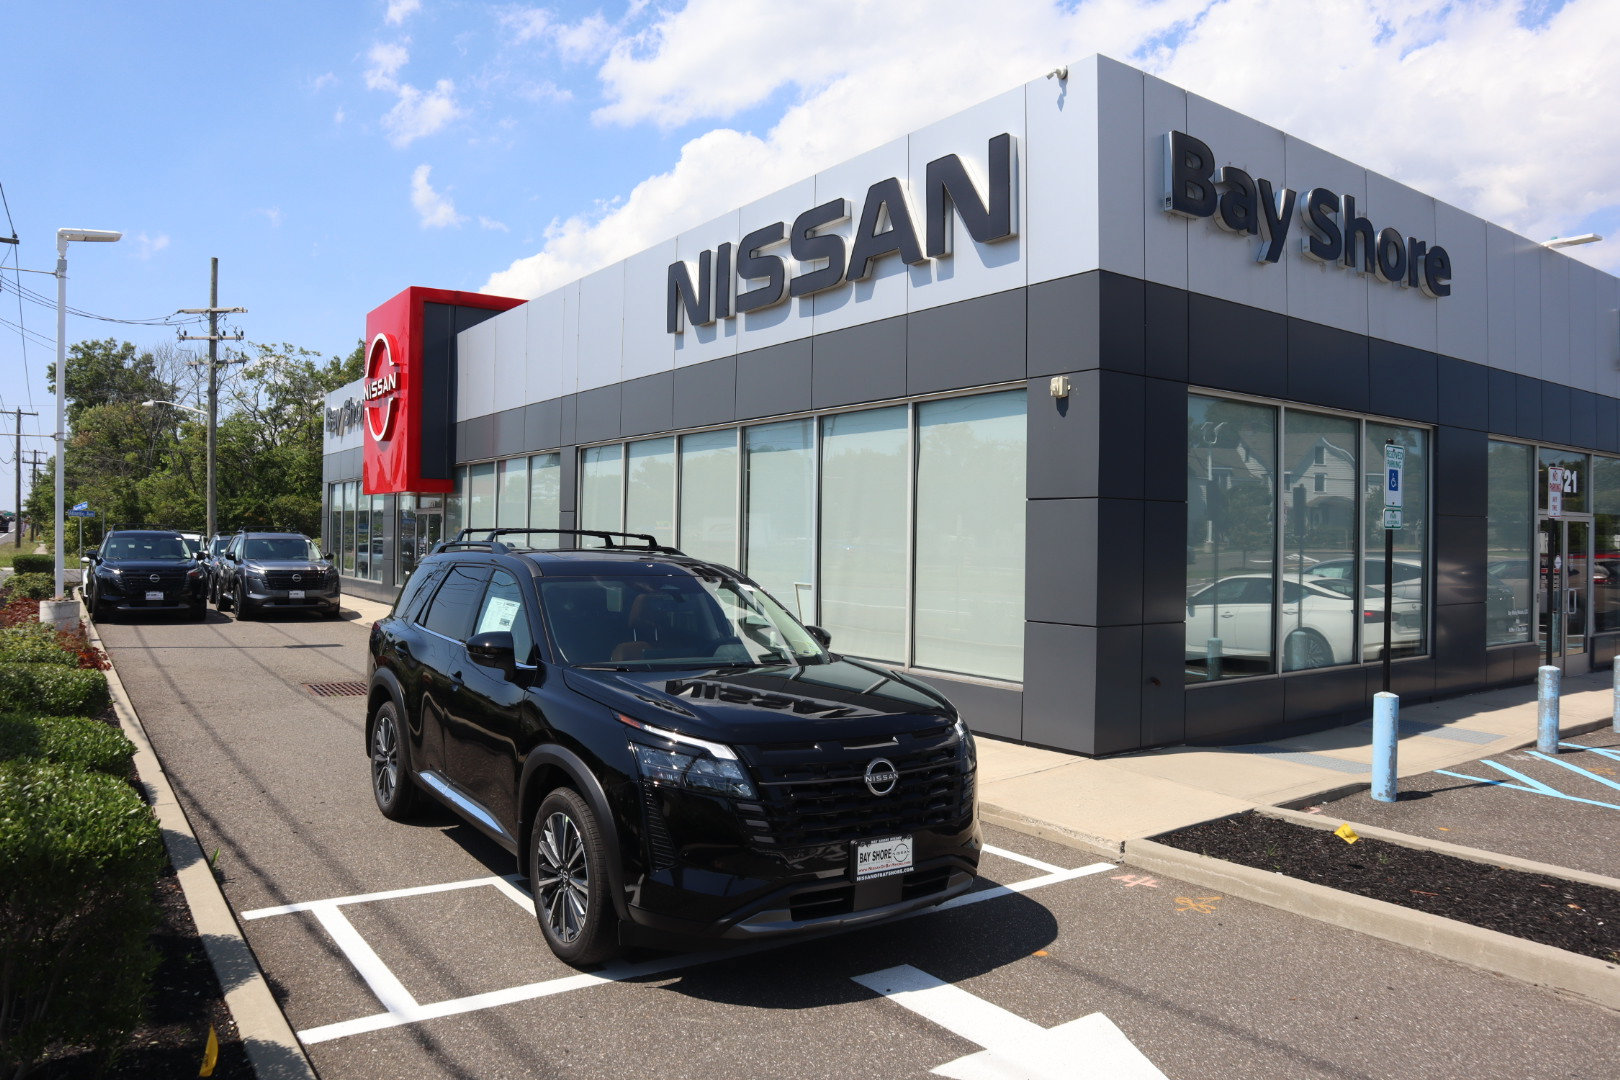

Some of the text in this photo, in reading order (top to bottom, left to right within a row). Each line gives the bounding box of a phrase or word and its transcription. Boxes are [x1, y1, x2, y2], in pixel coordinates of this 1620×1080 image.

[1164, 130, 1452, 299] Bay Shore
[667, 132, 1016, 334] NISSAN
[364, 371, 397, 402] NISSAN
[1561, 469, 1578, 493] 21
[865, 773, 899, 783] NISSAN
[860, 848, 892, 863] BAY SHORE
